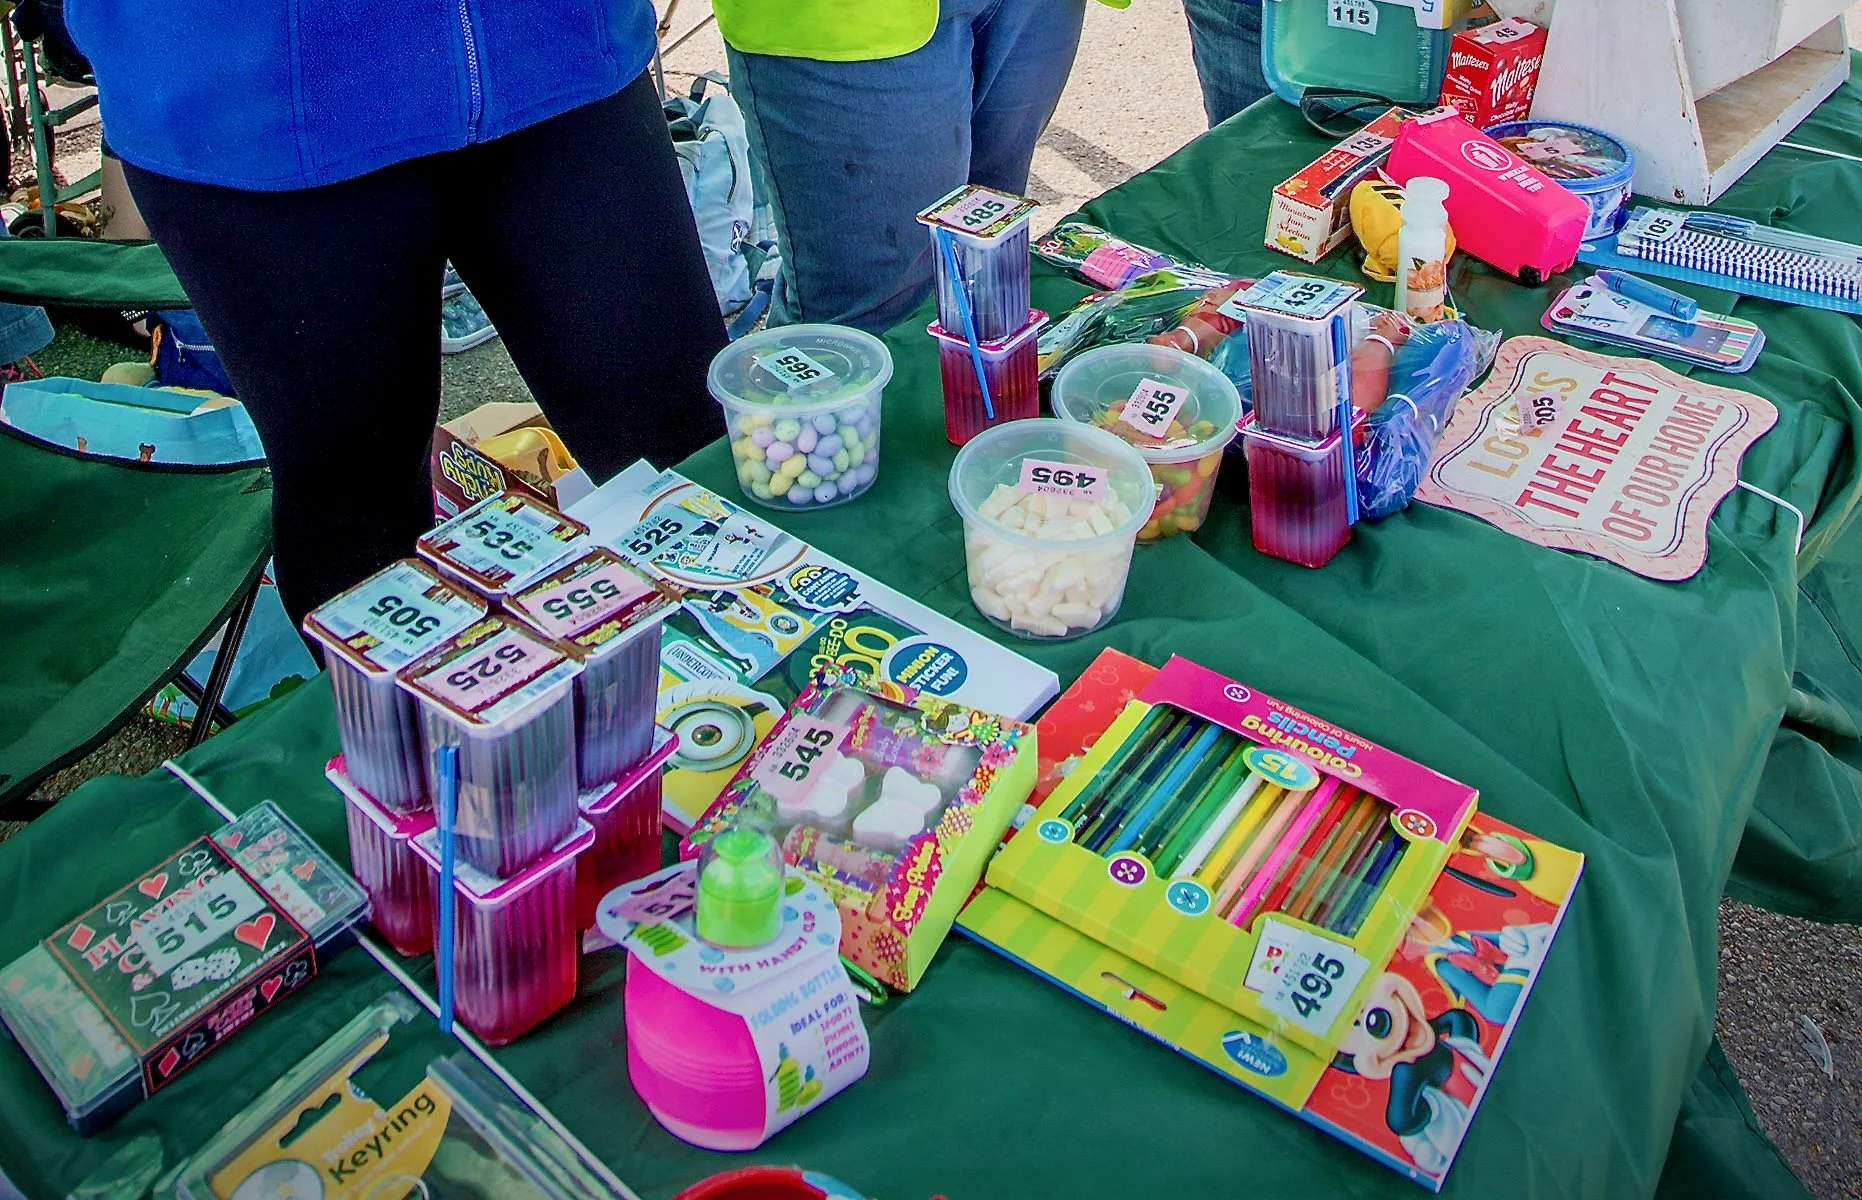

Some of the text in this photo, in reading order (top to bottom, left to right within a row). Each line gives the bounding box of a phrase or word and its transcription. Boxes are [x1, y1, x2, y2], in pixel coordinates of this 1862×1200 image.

[1334, 6, 1370, 25] 115
[1452, 52, 1489, 71] Maltesers
[1447, 74, 1482, 95] Chocolate Drink
[1490, 55, 1542, 108] Maltese
[1490, 108, 1515, 122] Chocolate
[1515, 104, 1527, 113] Drink
[1350, 135, 1383, 154] 135
[962, 200, 1004, 227] 485
[1277, 200, 1317, 222] Miniature
[1646, 217, 1673, 238] 105
[1277, 221, 1311, 241] Selection
[1284, 282, 1325, 308] 435
[776, 355, 820, 380] 565
[1141, 390, 1177, 426] 455
[1534, 397, 1555, 427] 205
[1515, 372, 1659, 519] THE HEART
[1032, 467, 1097, 488] 495
[1602, 394, 1725, 542] OF OUR HOME
[465, 520, 534, 560] 535
[628, 518, 683, 556] 525
[543, 579, 621, 620] 555
[368, 595, 441, 638] 505
[447, 644, 527, 692] 525
[672, 648, 723, 679] UNDERCOV
[897, 645, 940, 684] MINION
[909, 652, 954, 691] STICKER
[931, 667, 959, 692] FUN!
[1266, 699, 1284, 711] Fun
[1285, 704, 1330, 732] Colouring
[1241, 715, 1361, 778] Colouring
[1267, 711, 1357, 759] Pencils
[1344, 735, 1373, 751] Hours
[779, 727, 834, 782] 545
[1258, 754, 1297, 780] 15
[156, 892, 237, 955] 515
[700, 963, 750, 975] WITH
[757, 937, 808, 969] HANDY
[751, 965, 842, 1030] FOLDING BOTTLE
[1291, 952, 1345, 1019] 495
[790, 992, 849, 1035] IDEAL FOR:
[1237, 1050, 1271, 1074] NEW!
[328, 1093, 436, 1185] Keyring
